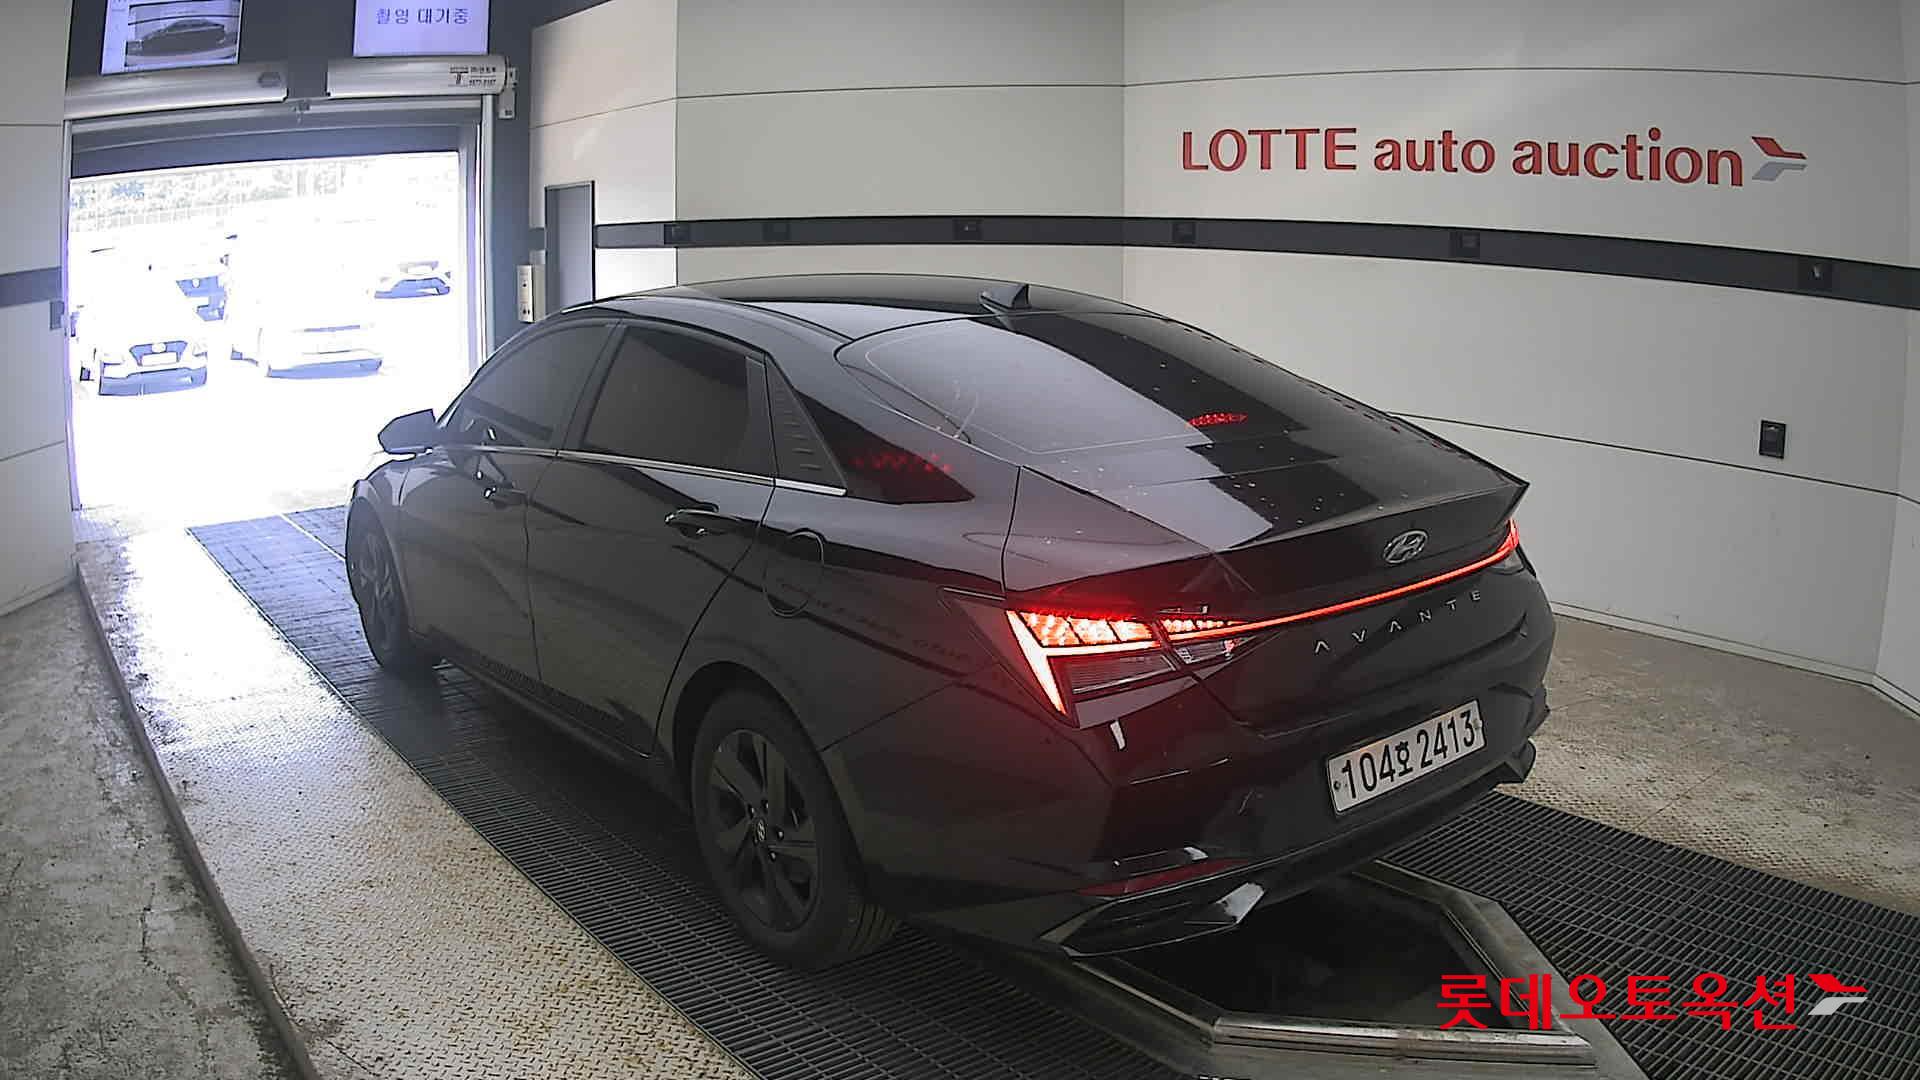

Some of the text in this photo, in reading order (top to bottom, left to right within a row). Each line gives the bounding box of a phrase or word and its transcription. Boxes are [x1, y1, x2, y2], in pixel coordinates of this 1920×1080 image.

[417, 7, 470, 25] 대기중
[1182, 127, 1744, 187] LOTTE auto auction
[1314, 589, 1482, 656] AVANTE
[1416, 709, 1477, 769] 2413
